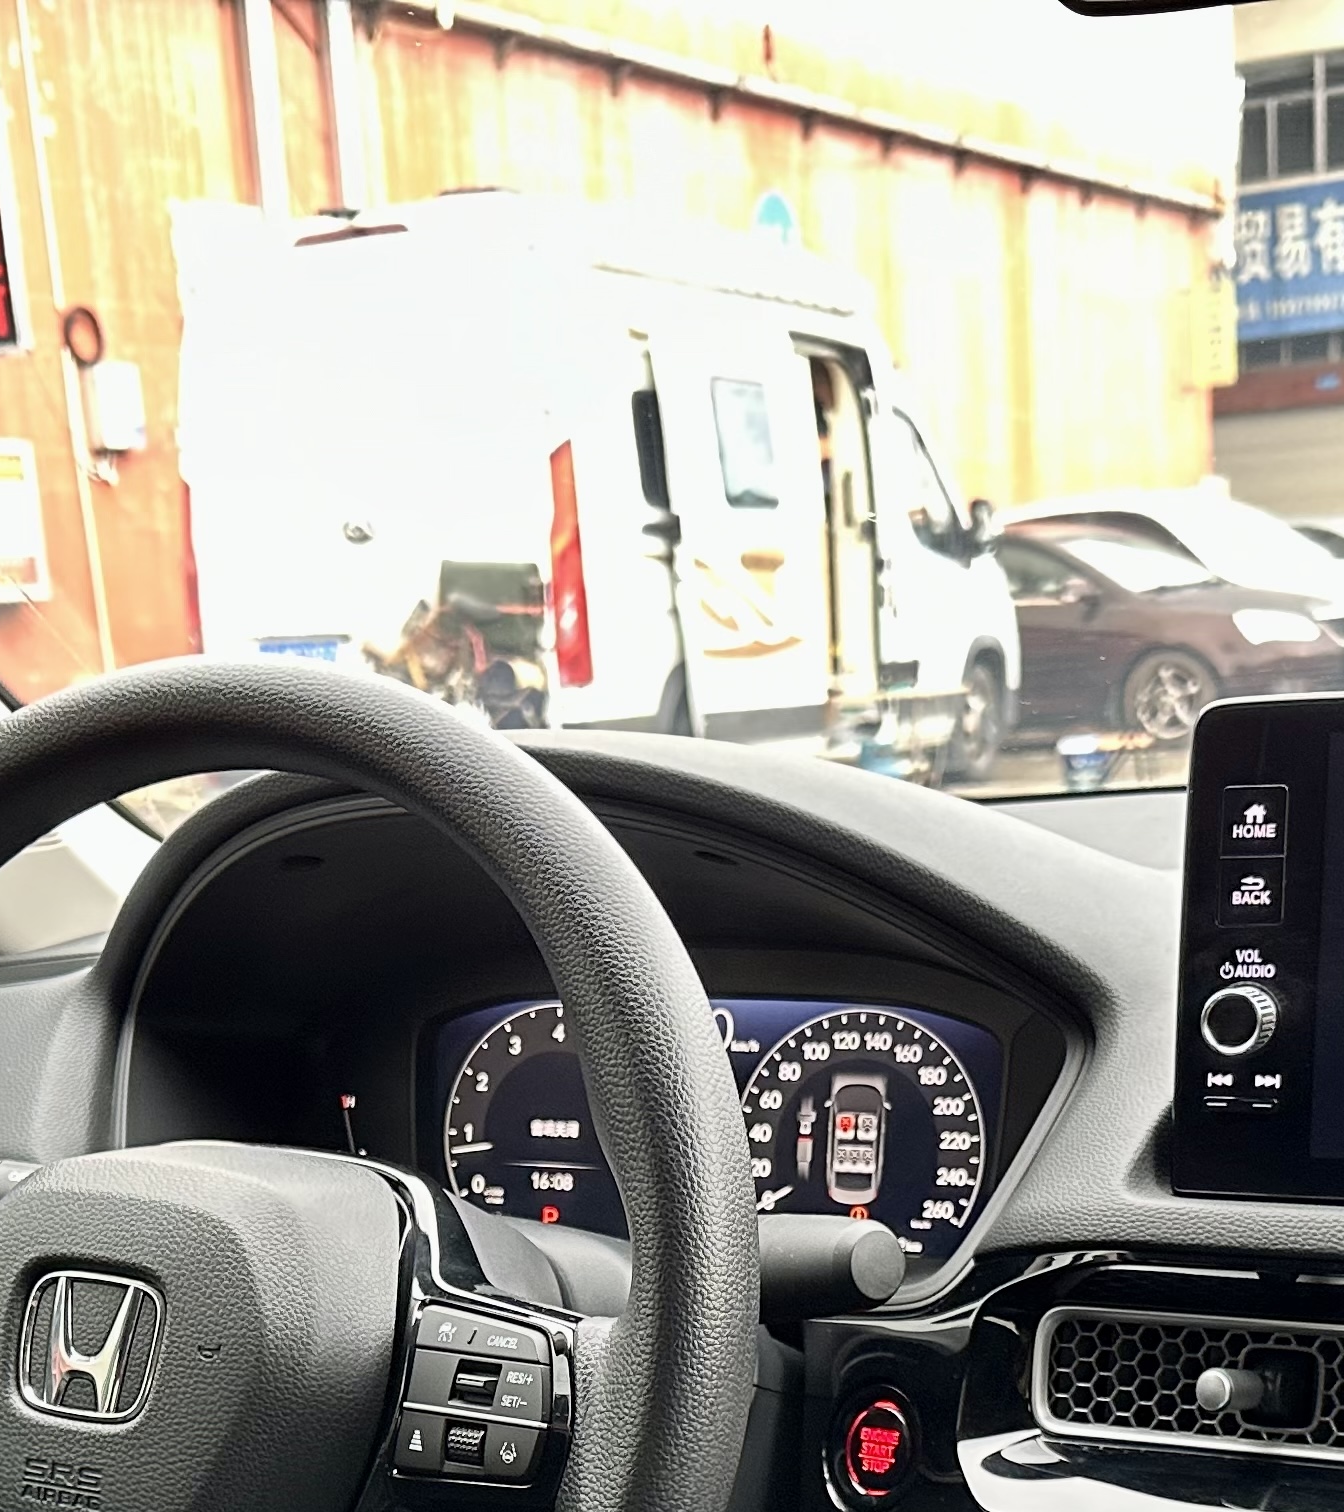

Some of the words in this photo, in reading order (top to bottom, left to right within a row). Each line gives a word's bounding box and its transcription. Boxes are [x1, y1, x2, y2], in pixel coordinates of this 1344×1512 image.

[1232, 823, 1277, 838] HOME
[1232, 890, 1272, 905] BACK
[1235, 949, 1263, 963] VOL
[1235, 964, 1276, 978] AUDIO
[552, 1023, 565, 1042] 4
[832, 1031, 860, 1050] 120
[864, 1032, 892, 1051] 140
[509, 1035, 522, 1056] 3
[802, 1041, 830, 1061] 100
[894, 1043, 922, 1064] 160
[475, 1071, 489, 1092] 2
[778, 1061, 801, 1082] 80
[918, 1066, 947, 1086] 180
[759, 1090, 782, 1110] 60
[933, 1097, 965, 1117] 200
[464, 1123, 473, 1142] 1
[749, 1123, 772, 1143] 40
[939, 1131, 970, 1151] 220
[471, 1174, 485, 1194] 0
[531, 1171, 574, 1192] 16:08
[936, 1168, 967, 1188] 240
[541, 1205, 560, 1224] P
[923, 1200, 954, 1220] 260
[486, 1335, 518, 1349] CANCEL
[861, 1442, 896, 1458] START
[862, 1459, 890, 1473] STOP
